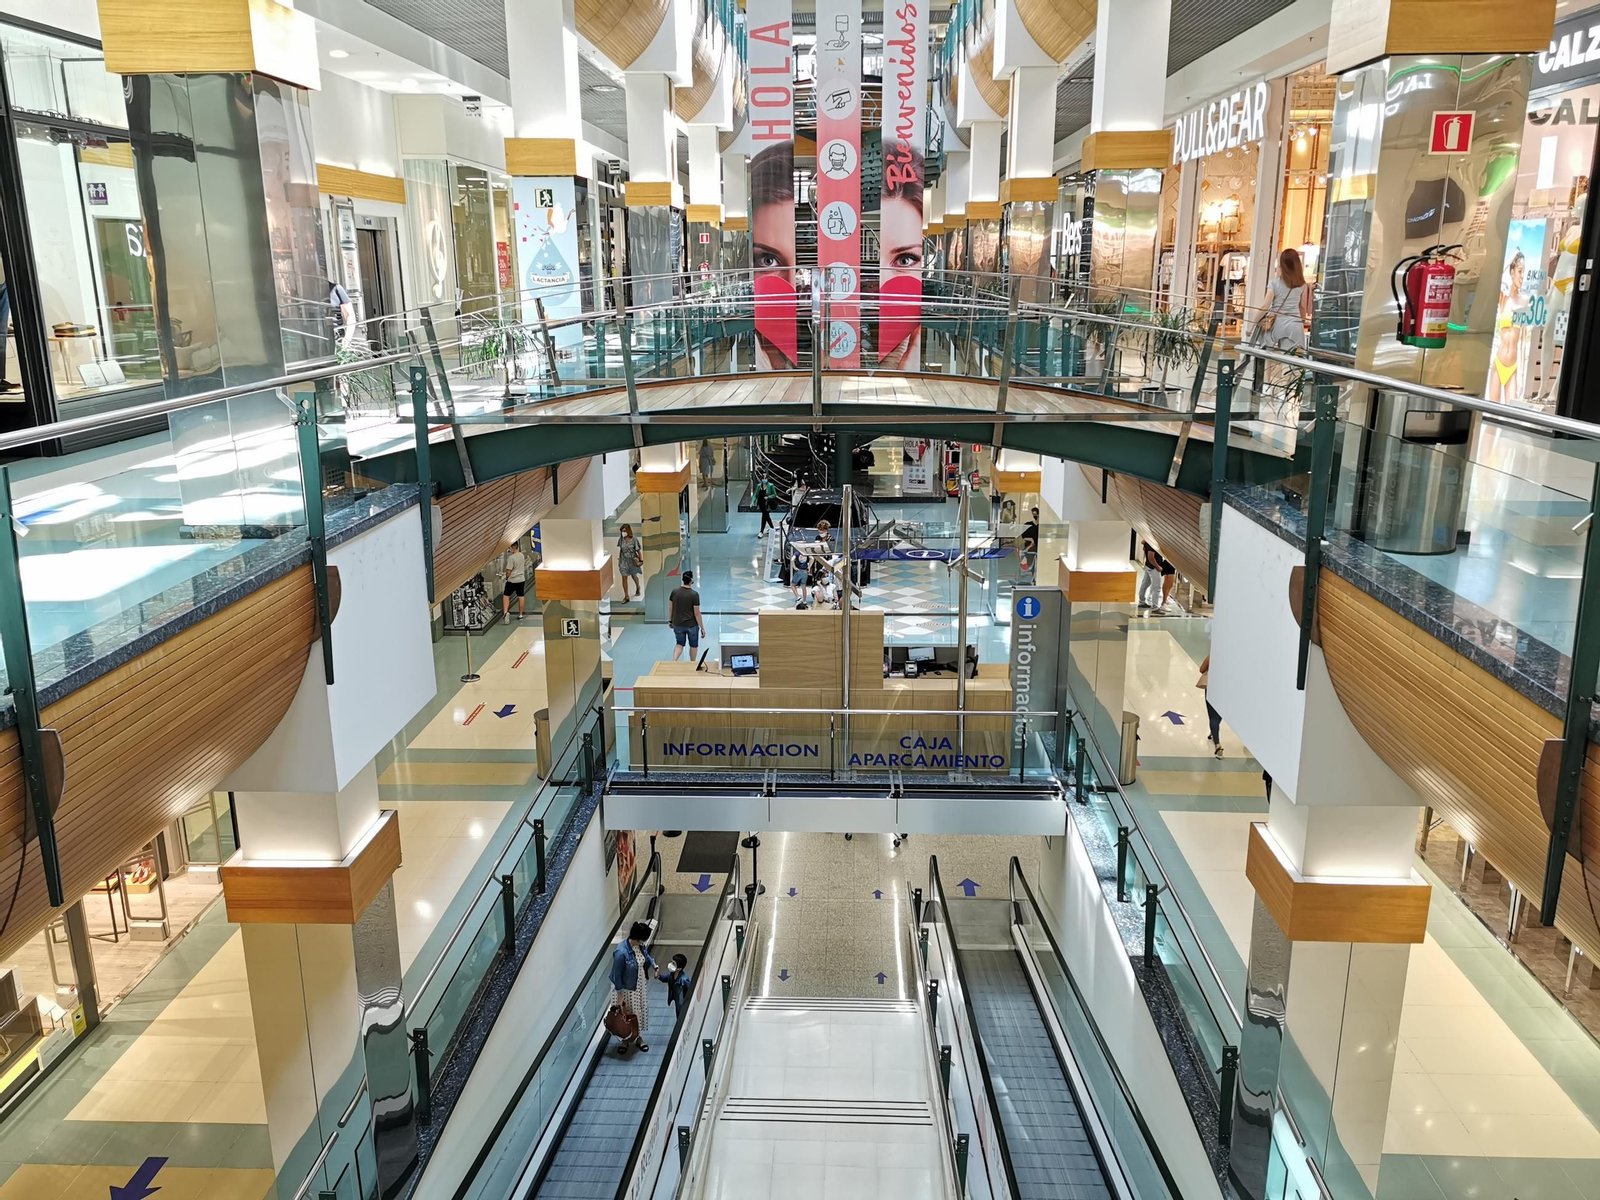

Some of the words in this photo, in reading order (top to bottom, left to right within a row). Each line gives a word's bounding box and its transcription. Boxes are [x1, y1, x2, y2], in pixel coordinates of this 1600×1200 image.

[750, 20, 792, 141] HOLA
[886, 0, 918, 190] Bienvenidos
[1172, 81, 1267, 166] PULL&BEAR
[662, 742, 819, 758] INFORMACION
[848, 753, 1005, 768] APARCAMIENTO
[899, 736, 953, 750] CAJA
